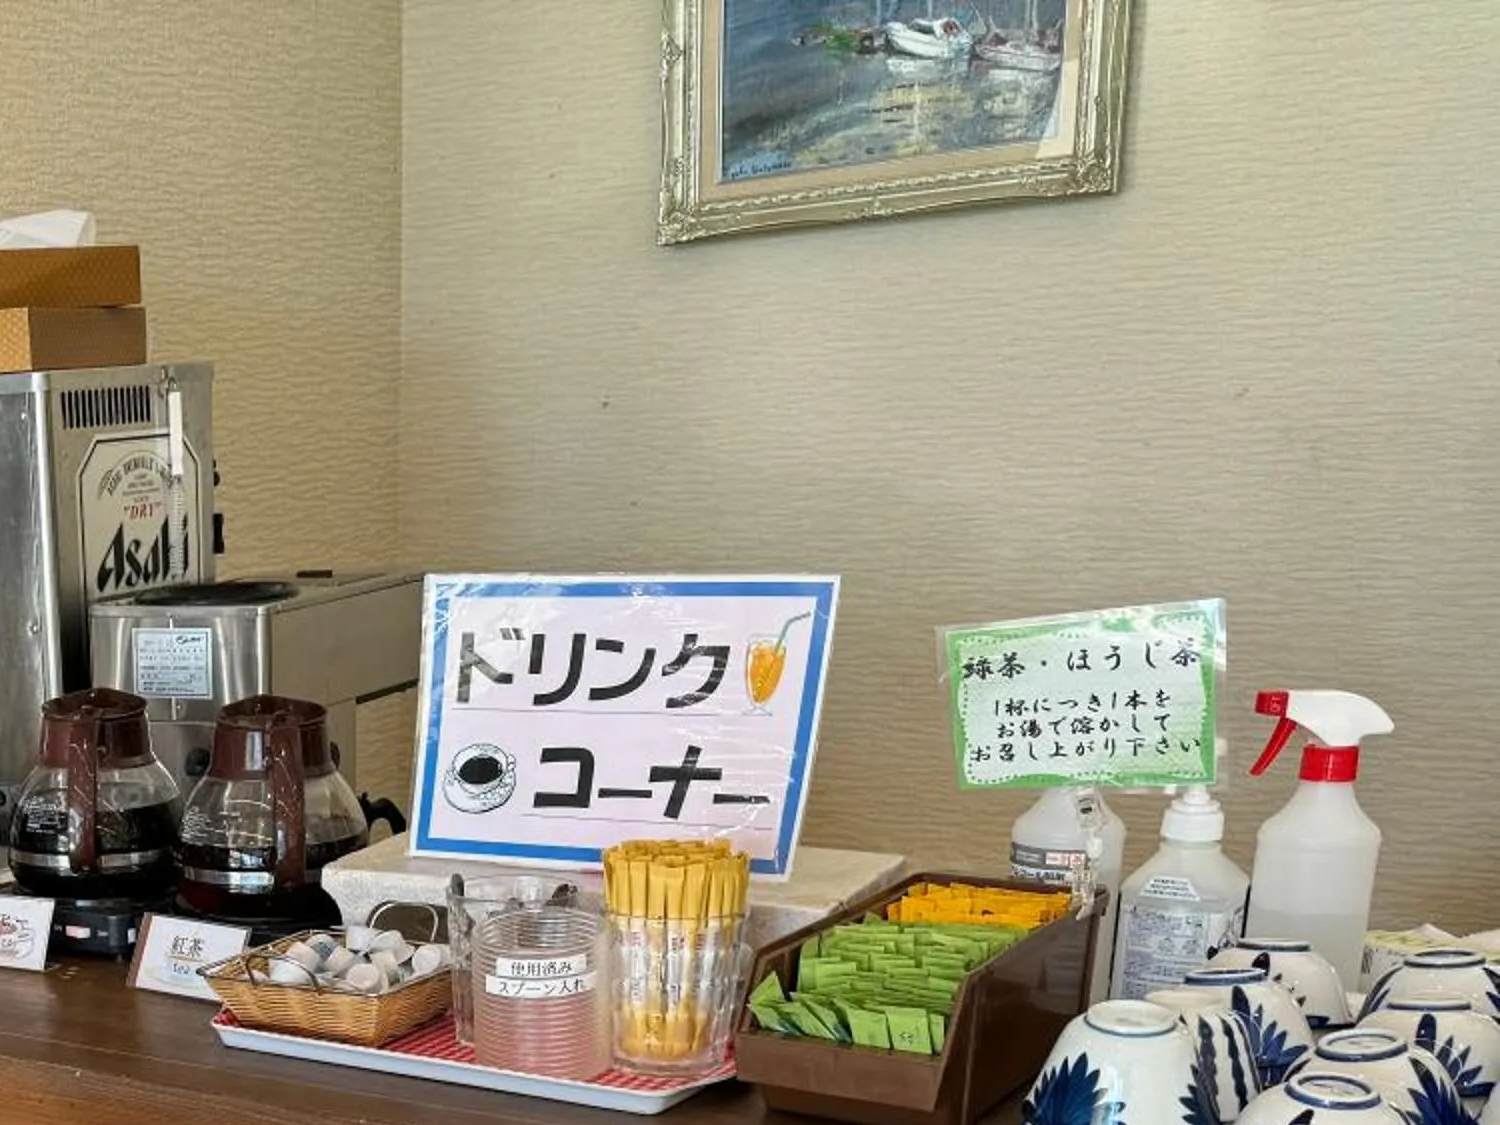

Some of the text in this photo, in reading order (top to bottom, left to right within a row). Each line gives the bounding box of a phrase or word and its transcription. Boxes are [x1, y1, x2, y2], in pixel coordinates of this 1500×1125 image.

[456, 627, 731, 709] ドリンク
[996, 713, 1171, 739] お湯で溶かして
[970, 736, 1201, 763] お召し上がり下さい
[533, 744, 771, 820] コーナー
[172, 935, 203, 957] 紅茶
[511, 961, 573, 977] 使用済み
